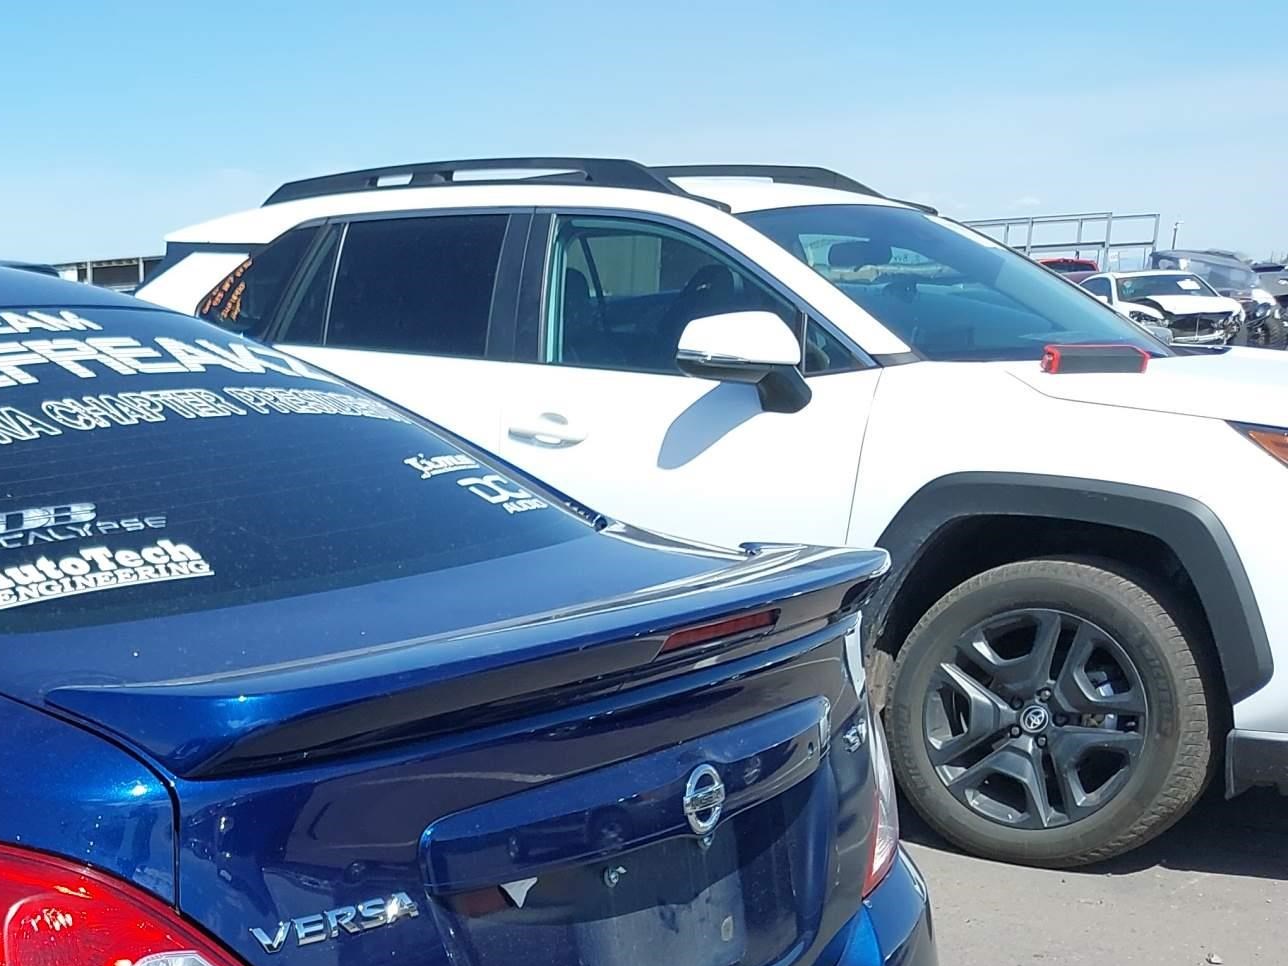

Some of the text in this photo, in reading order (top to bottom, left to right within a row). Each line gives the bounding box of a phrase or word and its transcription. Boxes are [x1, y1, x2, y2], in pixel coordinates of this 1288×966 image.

[41, 388, 247, 431] CHAPTER
[457, 474, 532, 503] DC
[249, 892, 419, 953] VERSA
